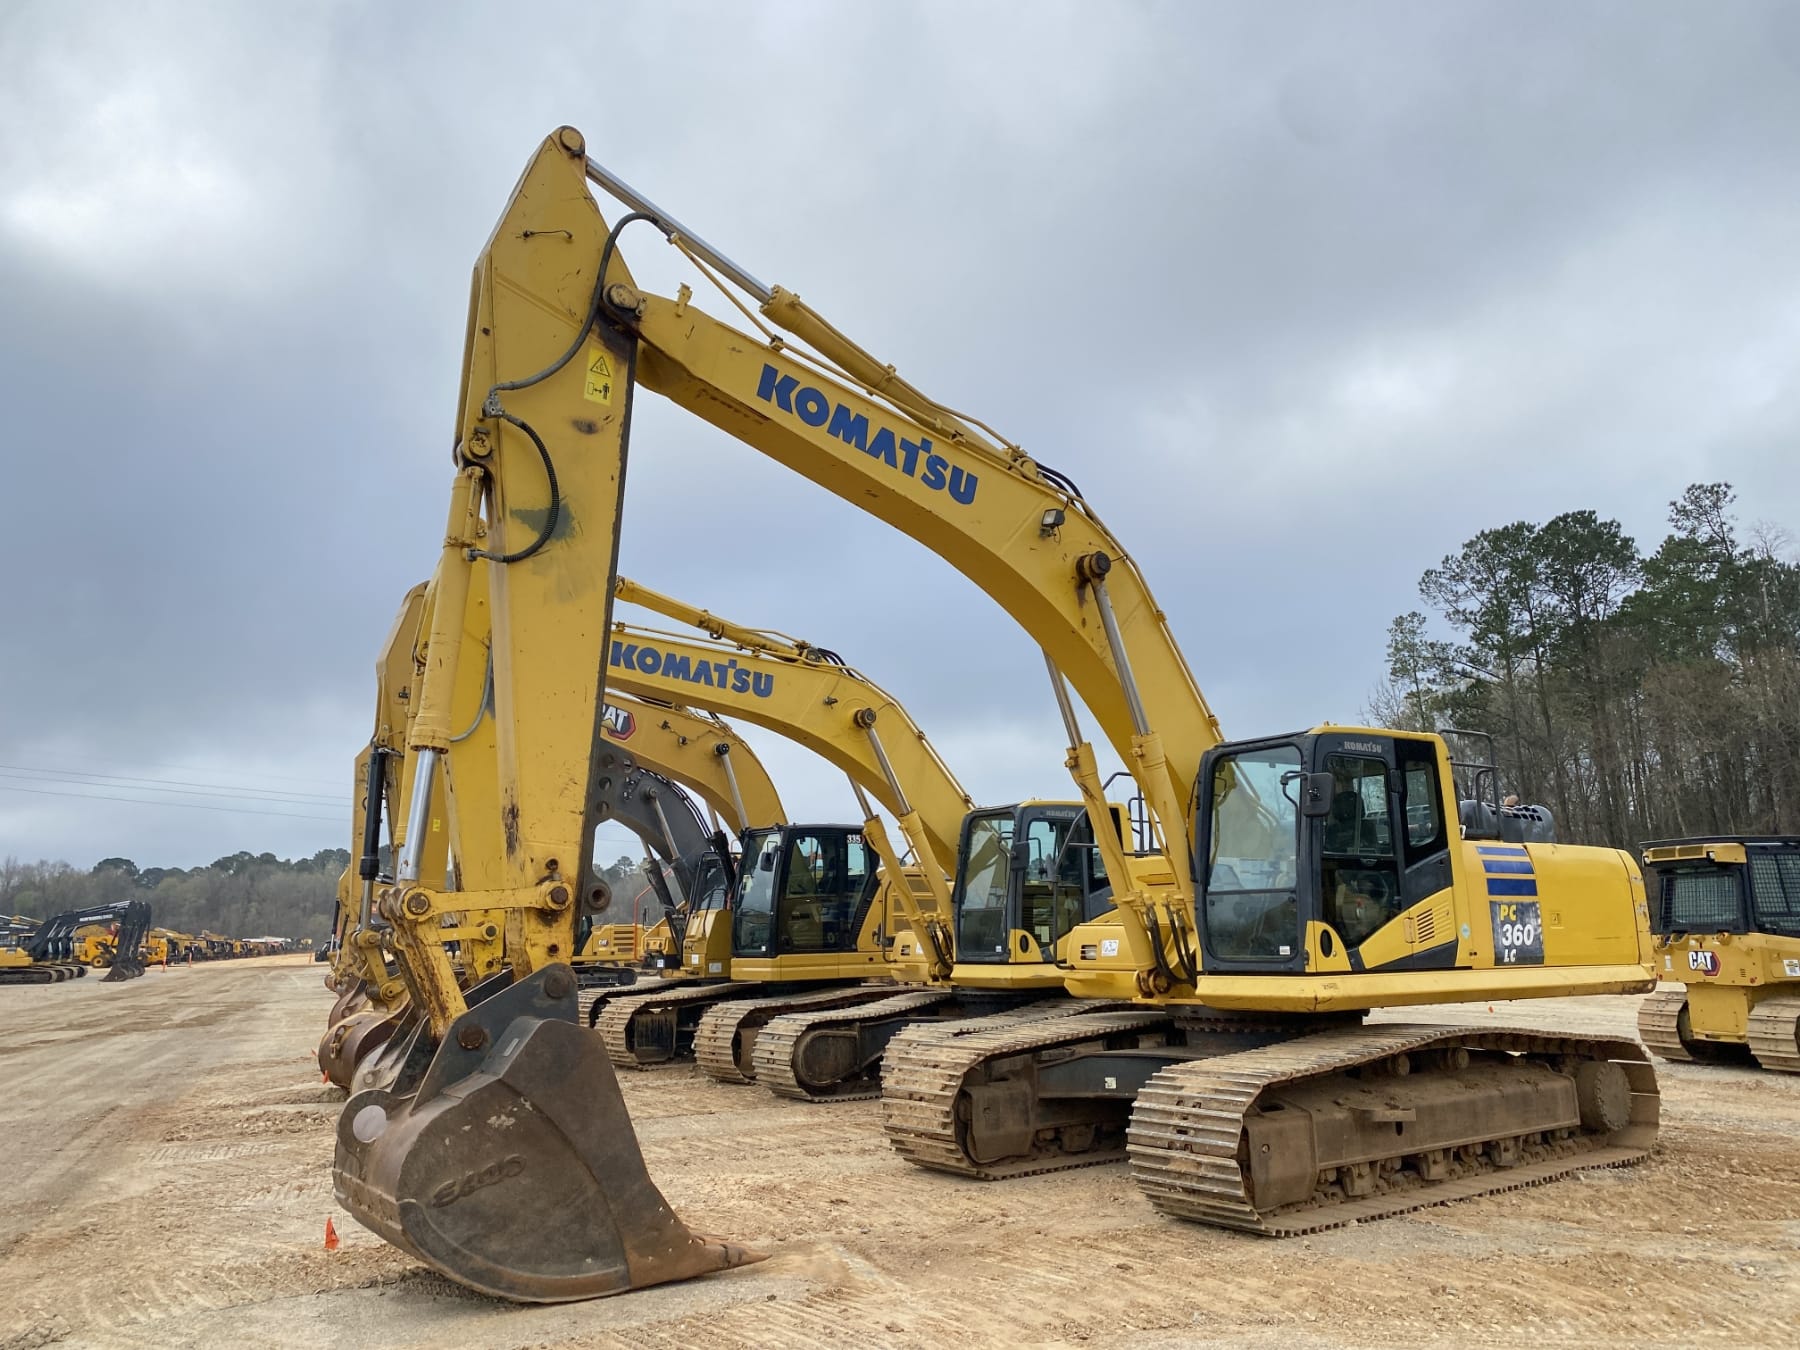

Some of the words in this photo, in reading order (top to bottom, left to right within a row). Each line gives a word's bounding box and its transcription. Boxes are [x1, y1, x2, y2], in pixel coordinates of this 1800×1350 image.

[757, 363, 978, 505] KOMATSU
[610, 641, 774, 698] KOMATSU
[602, 704, 628, 732] AT
[1344, 741, 1382, 753] KOMATSU
[1500, 904, 1517, 921] PC
[1502, 923, 1534, 946] 360
[1503, 948, 1517, 963] LC
[1688, 951, 1712, 970] CAT
